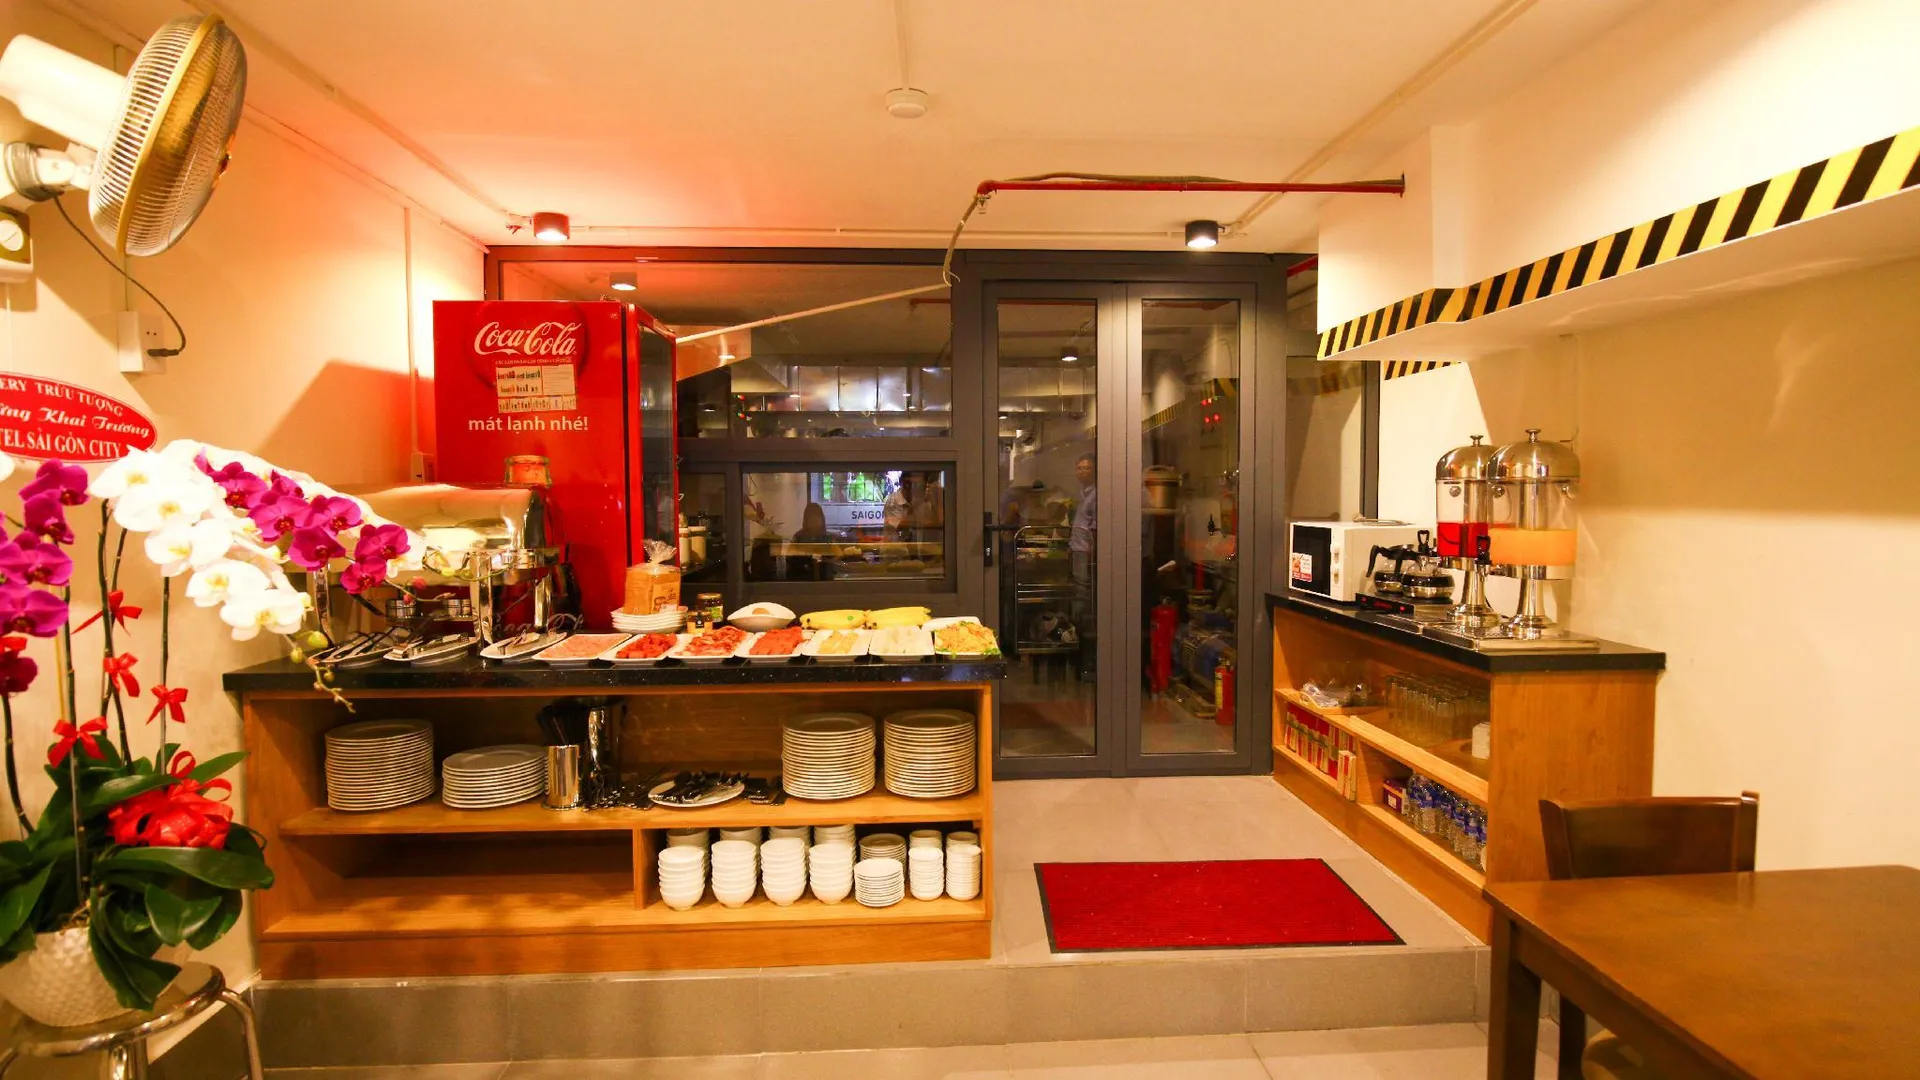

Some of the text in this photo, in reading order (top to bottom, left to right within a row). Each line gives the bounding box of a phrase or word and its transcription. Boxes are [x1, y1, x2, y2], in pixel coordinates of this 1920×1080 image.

[474, 321, 582, 356] Coca-Cola
[77, 392, 124, 417] TƯỢNG
[37, 407, 87, 427] Khai
[92, 416, 150, 438] Trương
[468, 415, 589, 434] mát lạnh nhé!
[27, 427, 52, 451] SÀI
[54, 431, 86, 454] GÒN
[89, 439, 121, 458] CITY
